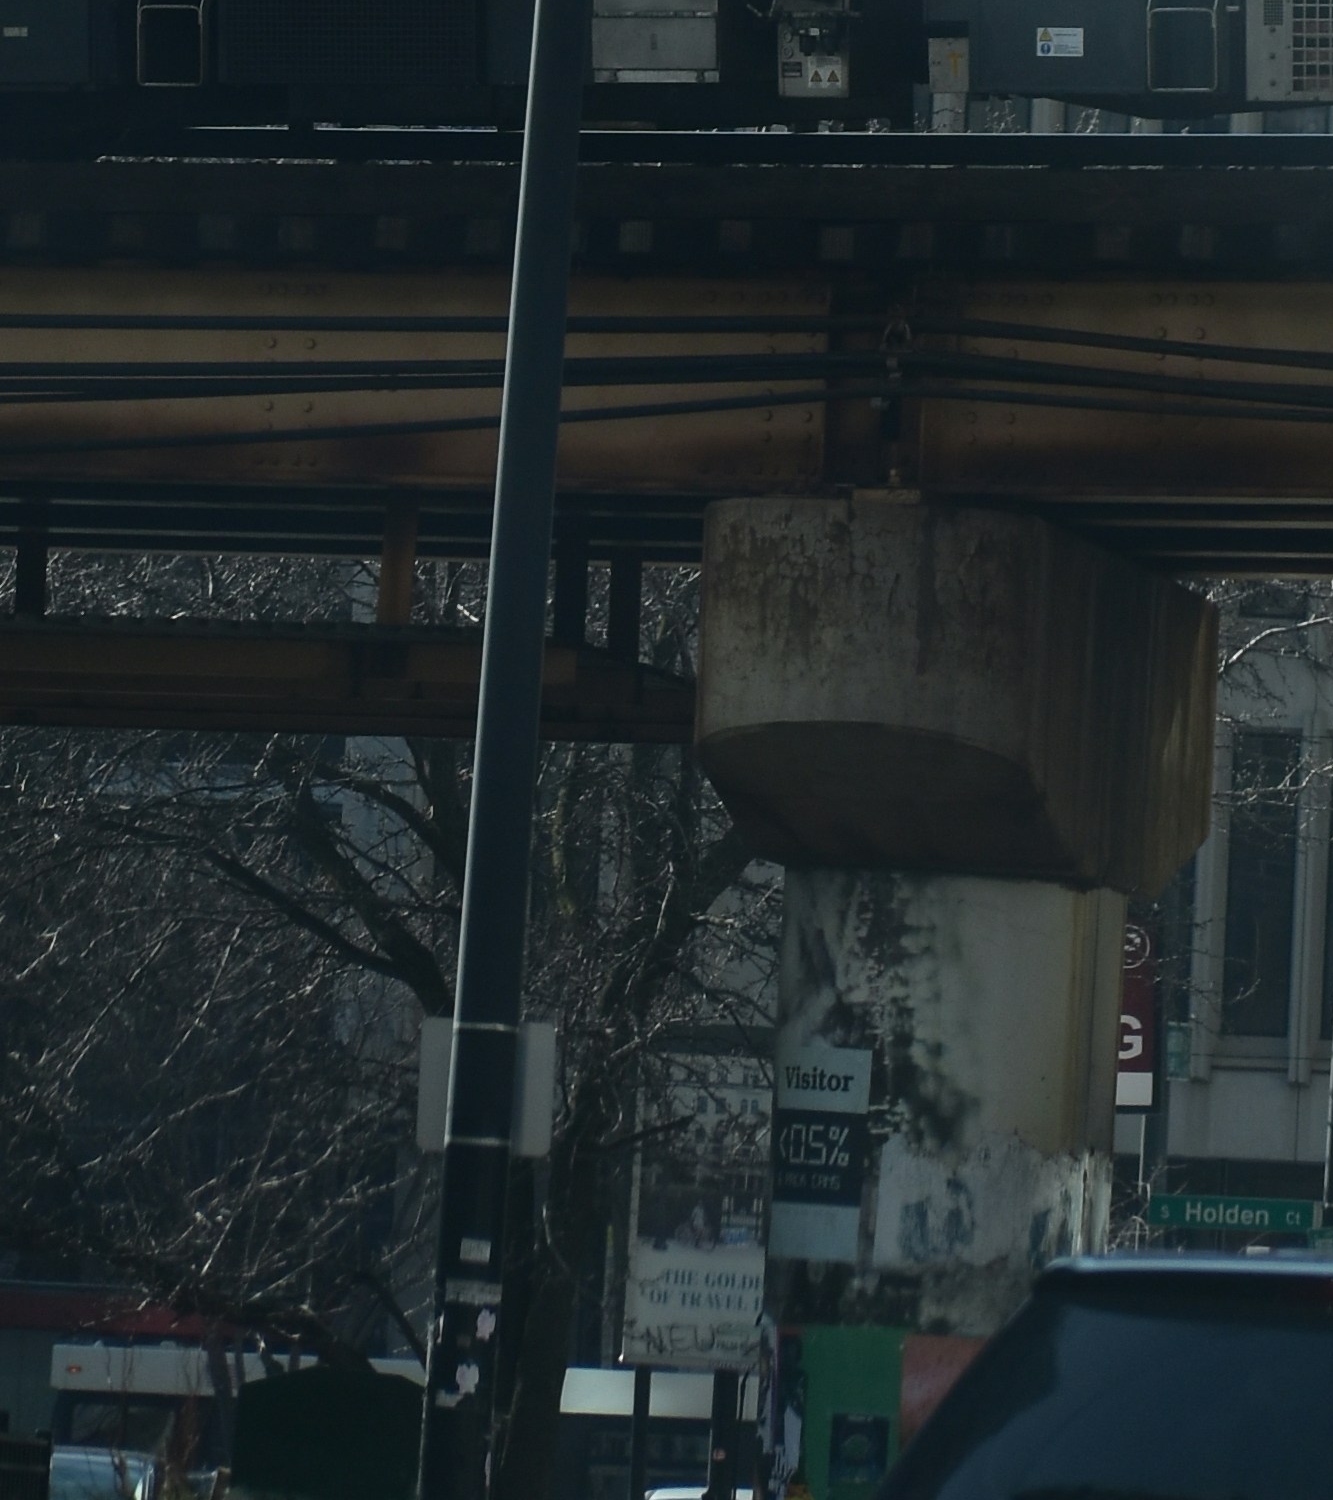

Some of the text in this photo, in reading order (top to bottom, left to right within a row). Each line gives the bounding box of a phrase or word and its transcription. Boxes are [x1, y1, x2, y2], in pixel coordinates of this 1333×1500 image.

[785, 1064, 855, 1092] Visitor
[1185, 1201, 1270, 1226] Holden
[664, 1268, 760, 1291] THE GOLD
